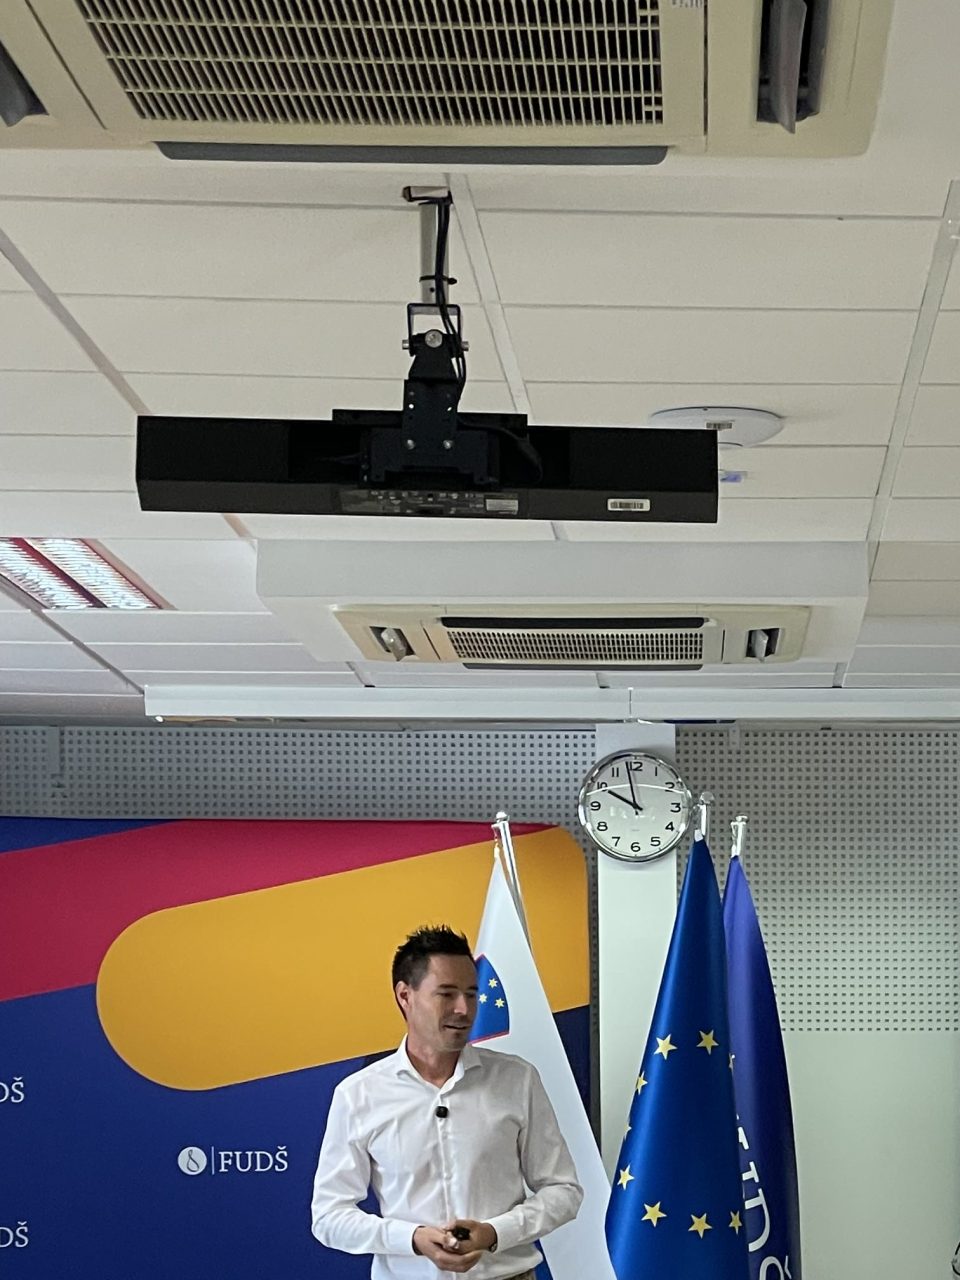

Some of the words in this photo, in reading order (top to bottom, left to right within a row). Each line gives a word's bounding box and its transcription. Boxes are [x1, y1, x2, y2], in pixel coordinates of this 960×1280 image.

[629, 761, 643, 772] 12
[611, 767, 619, 778] 11
[597, 781, 608, 792] 10
[665, 781, 675, 792] 2
[590, 801, 601, 811] 9
[670, 802, 681, 813] 3
[596, 821, 608, 832] 8
[665, 821, 675, 832] 4
[611, 836, 621, 847] 7
[630, 842, 641, 852] 6
[650, 836, 661, 847] 5
[218, 1145, 288, 1173] FUDŠ
